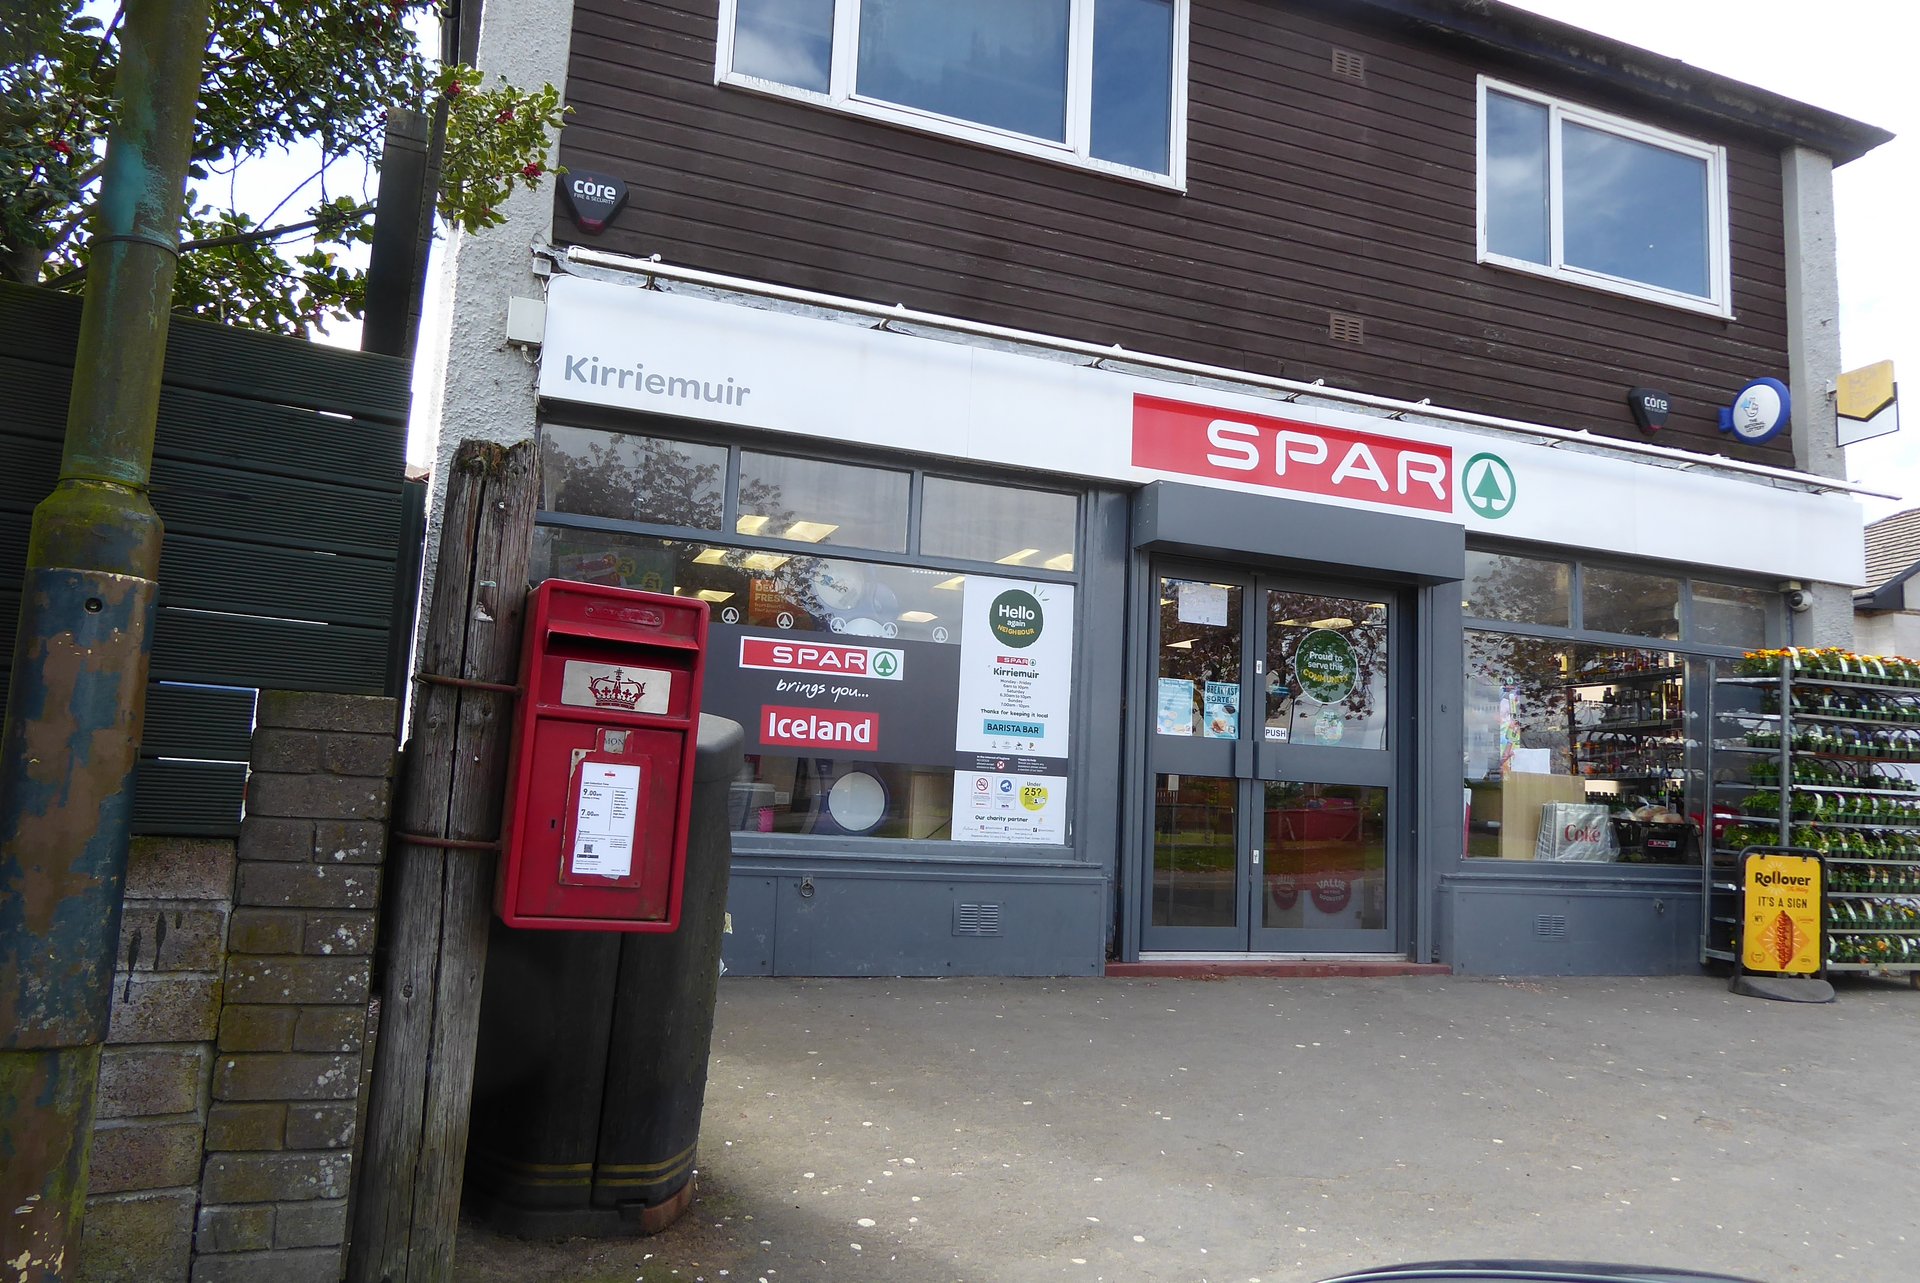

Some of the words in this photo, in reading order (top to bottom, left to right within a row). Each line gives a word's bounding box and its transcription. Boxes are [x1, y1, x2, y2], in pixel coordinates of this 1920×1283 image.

[574, 180, 616, 200] core
[591, 196, 615, 204] SECURITY
[564, 354, 751, 406] Kirriemuir
[1644, 397, 1667, 410] core
[1206, 419, 1446, 500] SPAR
[999, 604, 1035, 620] Hello
[997, 624, 1035, 635] NEIGHBOUR
[1007, 620, 1026, 628] again
[772, 646, 866, 670] SPAR
[1309, 651, 1333, 661] Proud
[1335, 654, 1344, 662] to
[1308, 662, 1328, 670] serve
[1329, 663, 1344, 671] this
[993, 667, 1039, 679] Kirriemuir
[1303, 668, 1349, 684] COMMUNITY
[776, 678, 826, 699] brings
[831, 684, 869, 702] you...
[1206, 685, 1238, 696] BREAKFAST
[1206, 695, 1238, 704] SORTED!
[1010, 710, 1030, 718] keeping
[768, 712, 871, 744] Iceland
[987, 723, 1021, 733] BARISTA
[1022, 726, 1039, 734] BAR
[1265, 729, 1286, 737] PUSH
[1024, 787, 1042, 797] 25?
[986, 815, 1006, 823] charity
[1564, 824, 1601, 844] Coke
[1316, 878, 1346, 891] VALUE
[1755, 871, 1811, 887] Rollover
[1758, 896, 1775, 907] IT'S
[1778, 898, 1784, 907] A
[1787, 898, 1808, 909] SIGN
